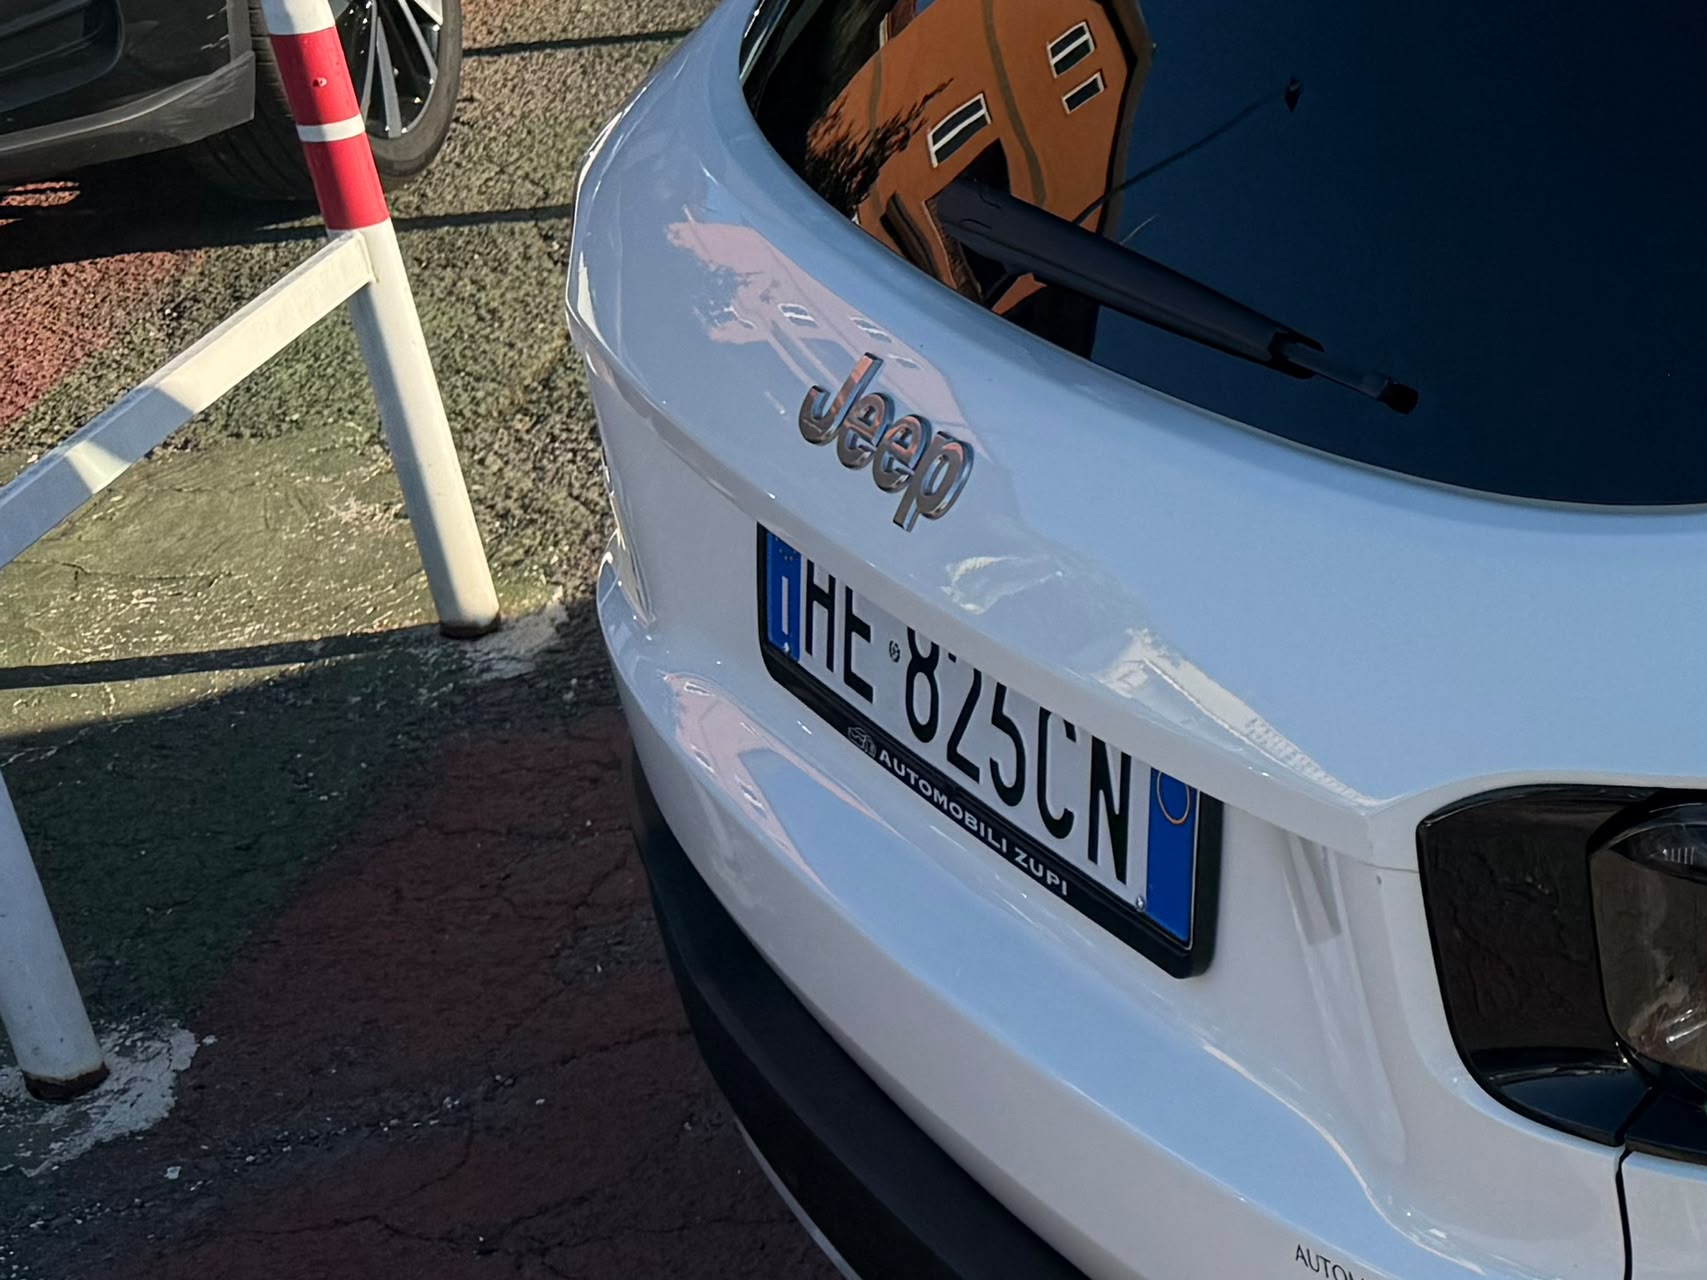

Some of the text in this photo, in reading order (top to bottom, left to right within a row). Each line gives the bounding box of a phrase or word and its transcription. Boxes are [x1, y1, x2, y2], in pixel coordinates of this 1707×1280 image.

[798, 351, 975, 533] Jeep
[879, 749, 1068, 896] AUTOMOBILI ZUPI
[904, 625, 1133, 887] 825CN
